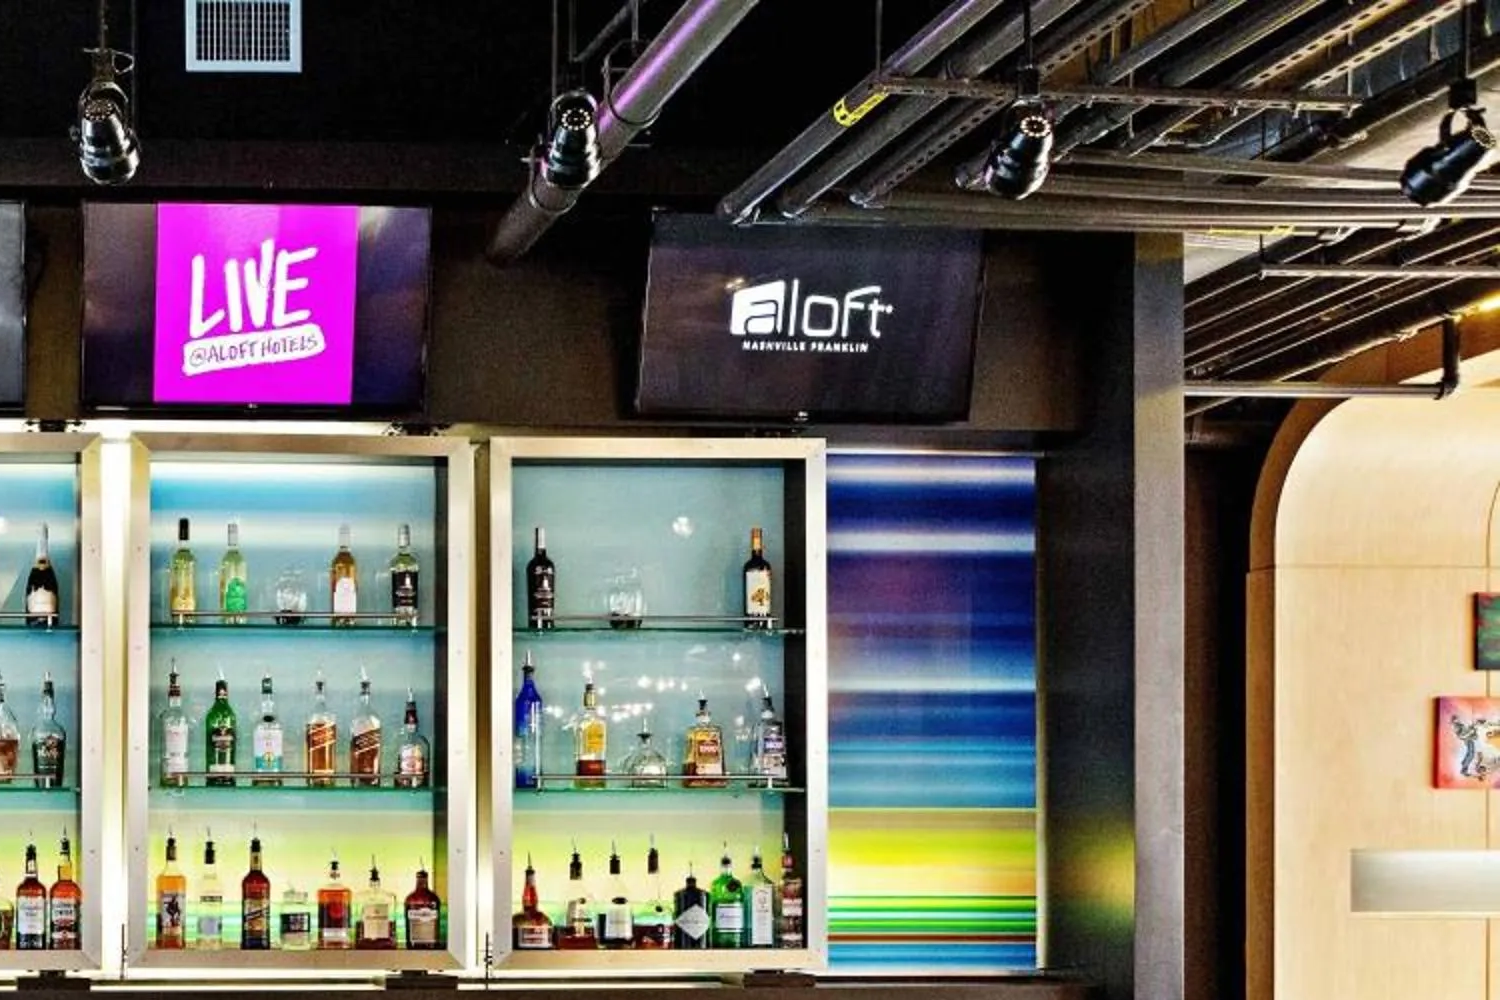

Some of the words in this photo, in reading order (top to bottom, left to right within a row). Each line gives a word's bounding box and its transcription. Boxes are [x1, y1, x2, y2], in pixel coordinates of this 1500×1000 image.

[189, 239, 319, 338] LIVE
[730, 278, 893, 338] aloft
[189, 340, 257, 368] @ALOFT
[261, 334, 318, 357] HOTELS
[742, 341, 805, 351] NASHVILLE
[810, 341, 869, 352] FRANKLIN
